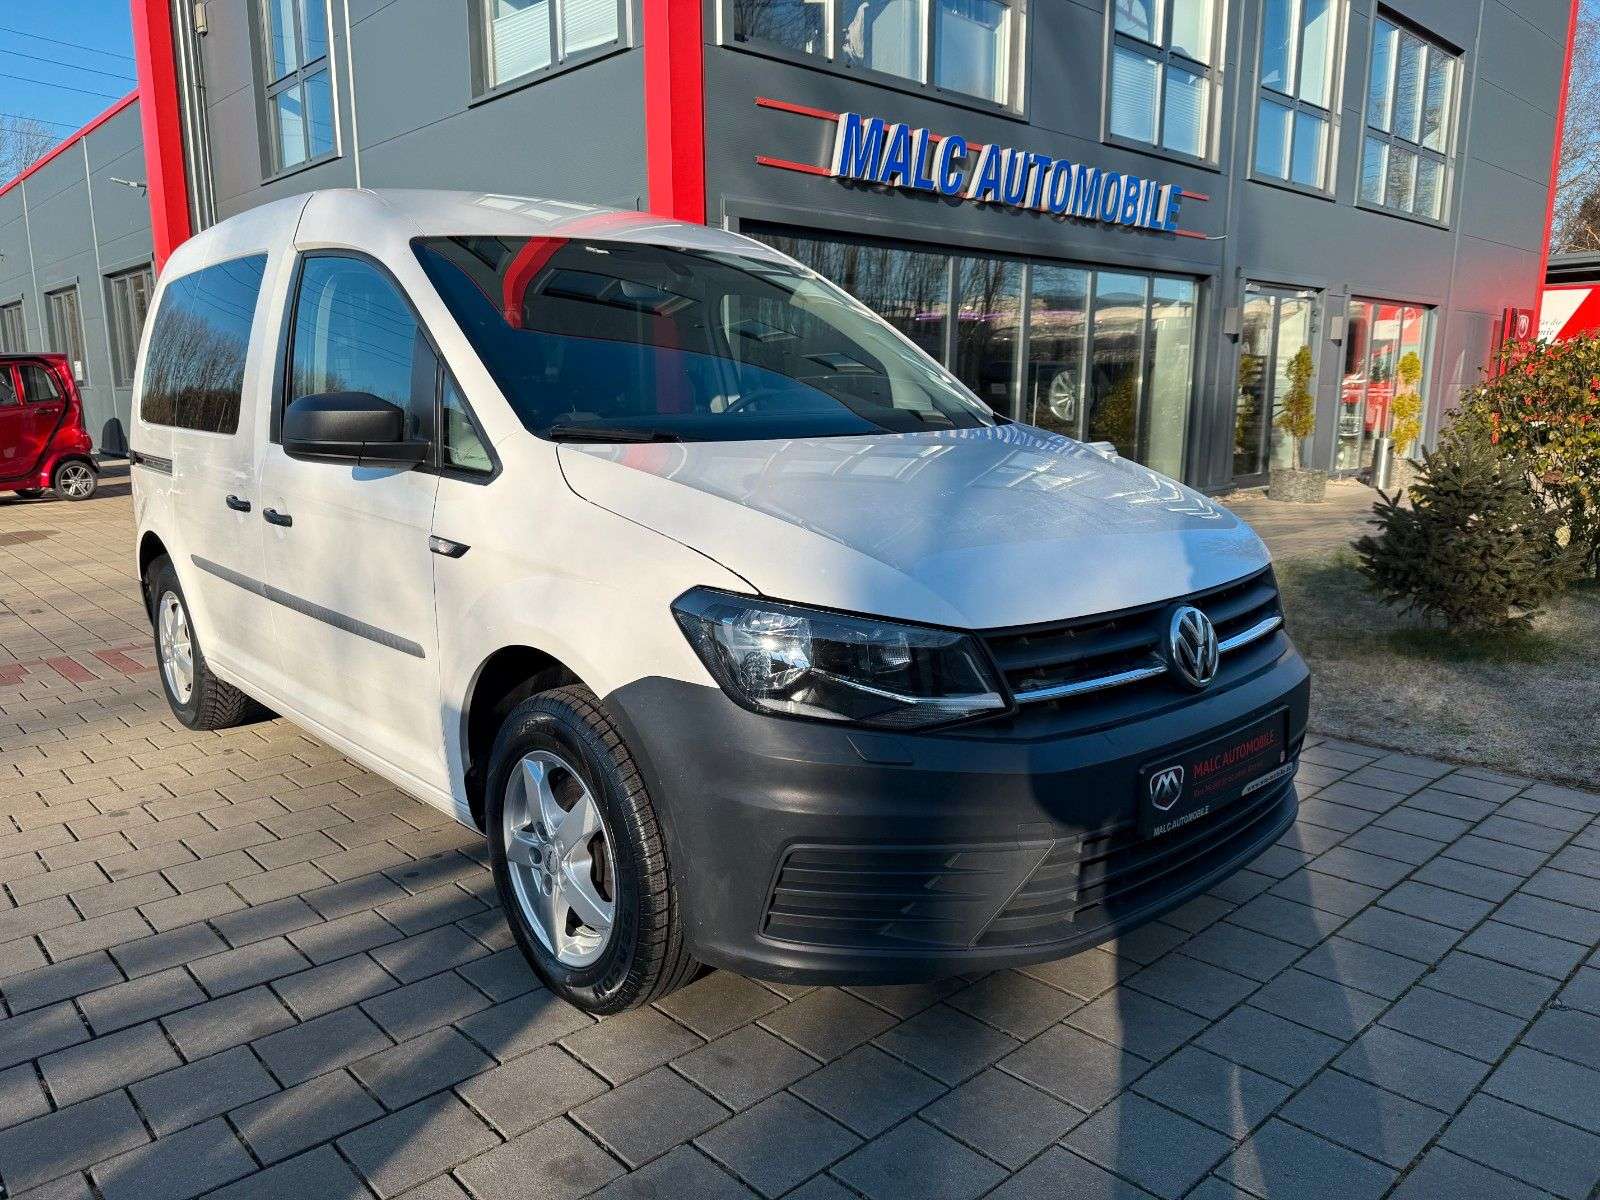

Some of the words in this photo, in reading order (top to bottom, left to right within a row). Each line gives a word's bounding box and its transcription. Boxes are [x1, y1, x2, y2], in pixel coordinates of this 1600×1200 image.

[831, 112, 968, 196] MALC
[966, 143, 1184, 232] AUTOMOBILE
[1193, 753, 1221, 779] MALC
[1222, 730, 1275, 766] AUTOMOBILE
[1171, 805, 1210, 830] AUTOMOBILE
